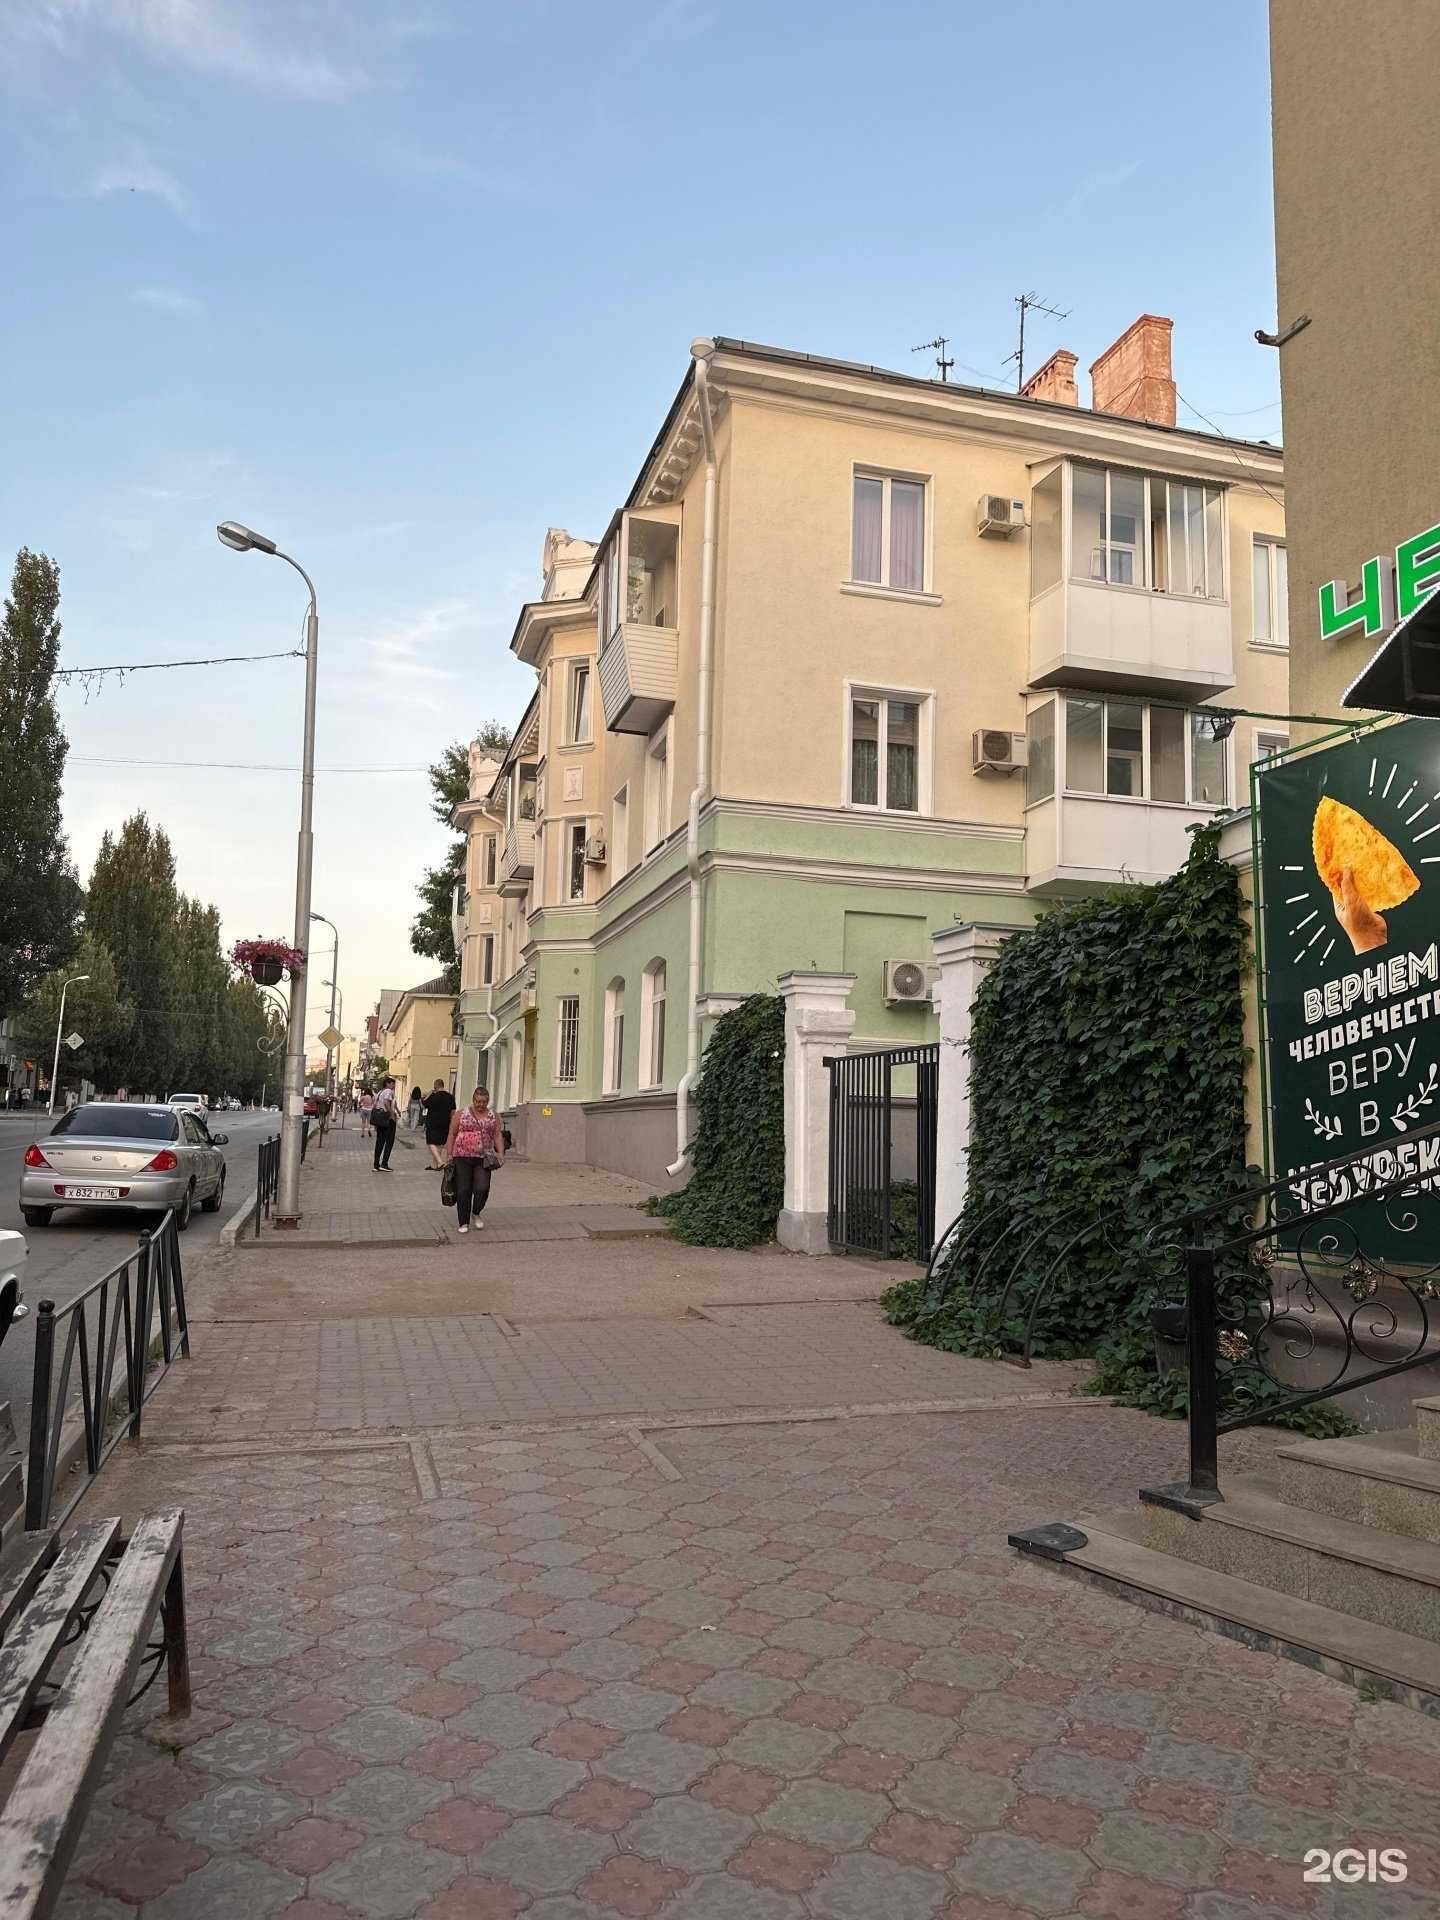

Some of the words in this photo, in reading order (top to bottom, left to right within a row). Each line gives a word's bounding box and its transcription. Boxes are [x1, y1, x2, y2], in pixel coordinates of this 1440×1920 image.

[1303, 942, 1438, 1025] ВЕРНЕМ
[1329, 1037, 1416, 1096] ВЕРУ
[1360, 1100, 1380, 1137] В
